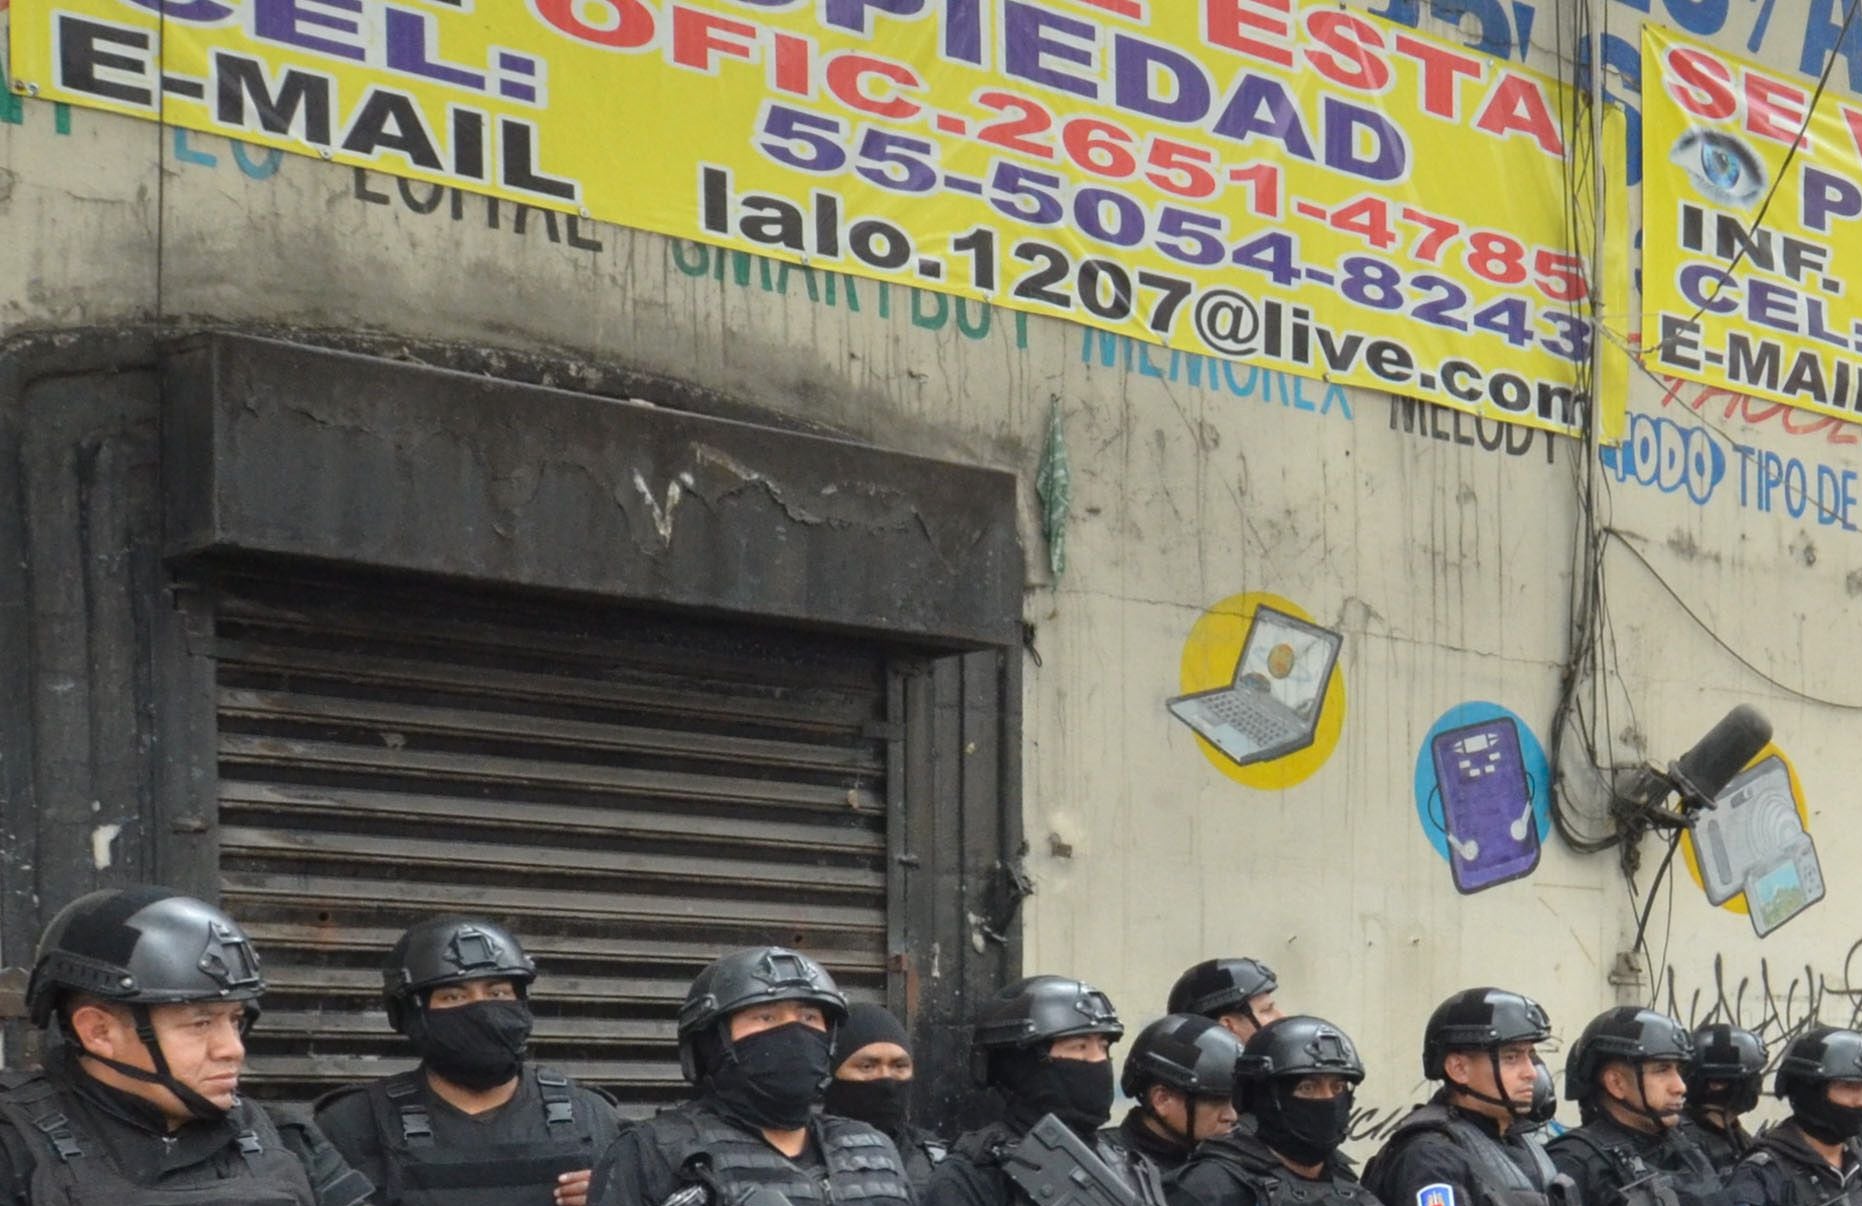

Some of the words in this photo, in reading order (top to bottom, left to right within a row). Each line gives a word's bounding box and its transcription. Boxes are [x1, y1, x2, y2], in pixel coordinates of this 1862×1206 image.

[59, 15, 575, 200] E-MAIL
[1206, 0, 1567, 157] ESTA
[1663, 48, 1808, 148] SE
[760, 104, 1593, 363] 55-5054-8243
[1683, 205, 1840, 294] INF.
[1735, 445, 1807, 518] TIPO
[1817, 464, 1857, 531] DE
